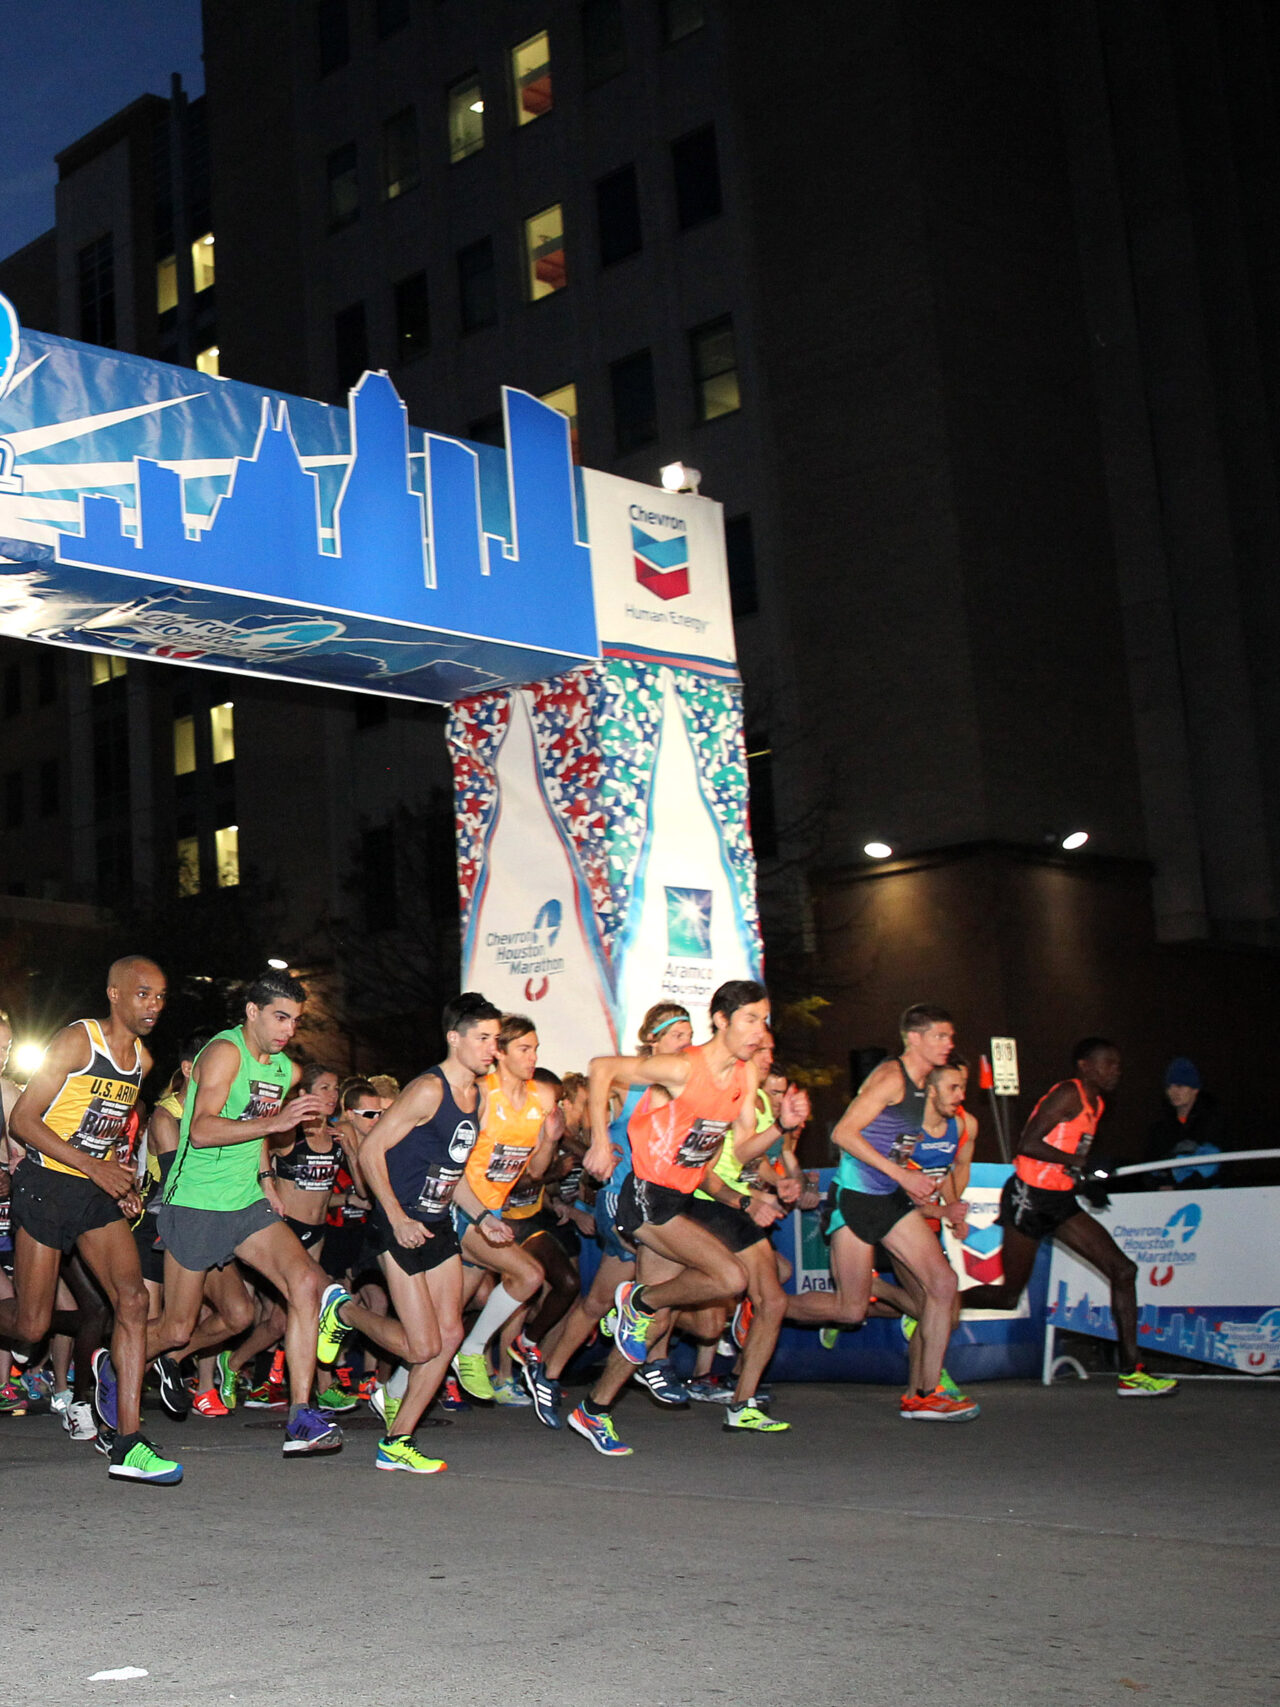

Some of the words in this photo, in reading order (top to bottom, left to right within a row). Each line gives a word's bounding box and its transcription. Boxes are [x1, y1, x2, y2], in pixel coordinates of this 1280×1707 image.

[629, 504, 687, 531] Chevron
[143, 614, 241, 636] Chron
[625, 604, 668, 622] Human
[669, 611, 708, 633] Energy
[486, 931, 535, 947] Chevron
[496, 944, 546, 961] Houston
[508, 956, 565, 975] Marathon
[90, 1079, 112, 1098] U.S.
[1113, 1226, 1163, 1237] Chevron
[1123, 1238, 1175, 1250] Houston
[1136, 1250, 1197, 1263] Marathon
